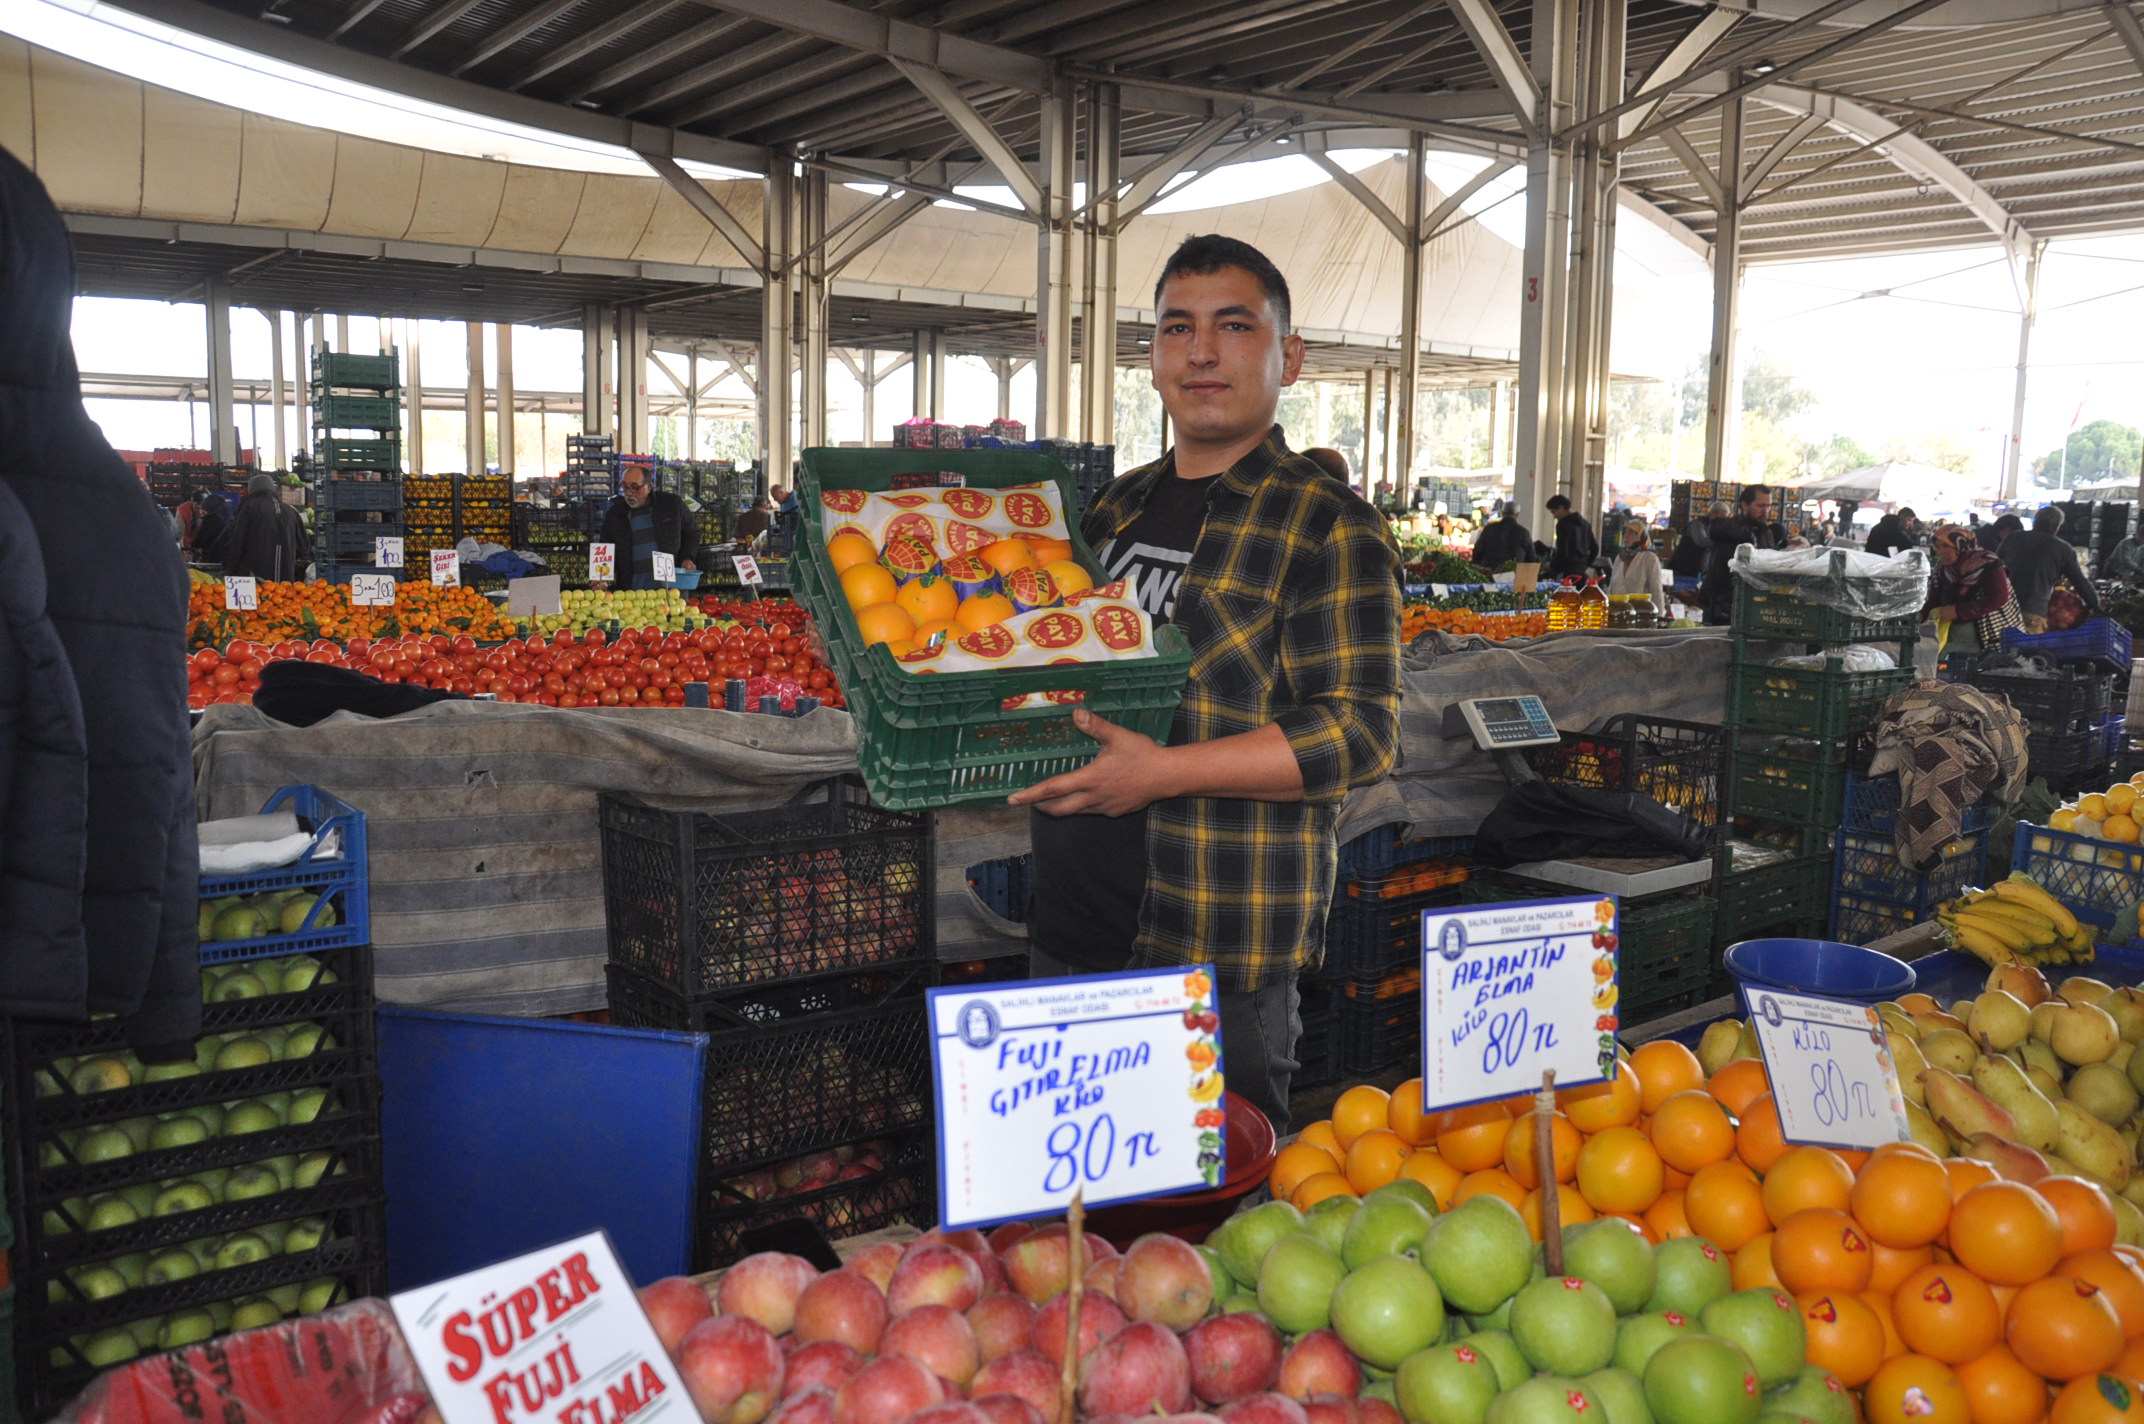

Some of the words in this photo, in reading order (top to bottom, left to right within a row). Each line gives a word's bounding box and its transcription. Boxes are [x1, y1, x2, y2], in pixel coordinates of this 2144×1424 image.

[1527, 277, 1538, 302] 3
[1022, 497, 1035, 524] PAY
[376, 537, 384, 550] 3
[656, 556, 674, 577] 50
[226, 576, 234, 590] 3
[352, 577, 364, 596] 3
[370, 577, 394, 599] 100
[977, 627, 998, 651] PAY
[1043, 616, 1067, 641] PAY
[1107, 610, 1130, 641] PAY
[1452, 938, 1566, 990] ARJANTİN
[1474, 971, 1533, 1007] ELMA
[1483, 1006, 1528, 1075] 80
[1533, 1023, 1559, 1052] TL
[1792, 1020, 1831, 1052] KİLO
[1065, 1041, 1151, 1088] ELMA
[1811, 1058, 1848, 1127] 80
[1851, 1081, 1876, 1118] TL
[1043, 1112, 1116, 1193] 80
[1124, 1131, 1162, 1168] TL
[441, 1251, 601, 1383] SÜPER
[482, 1332, 581, 1424] FUJİ
[556, 1360, 667, 1424] ELMA
